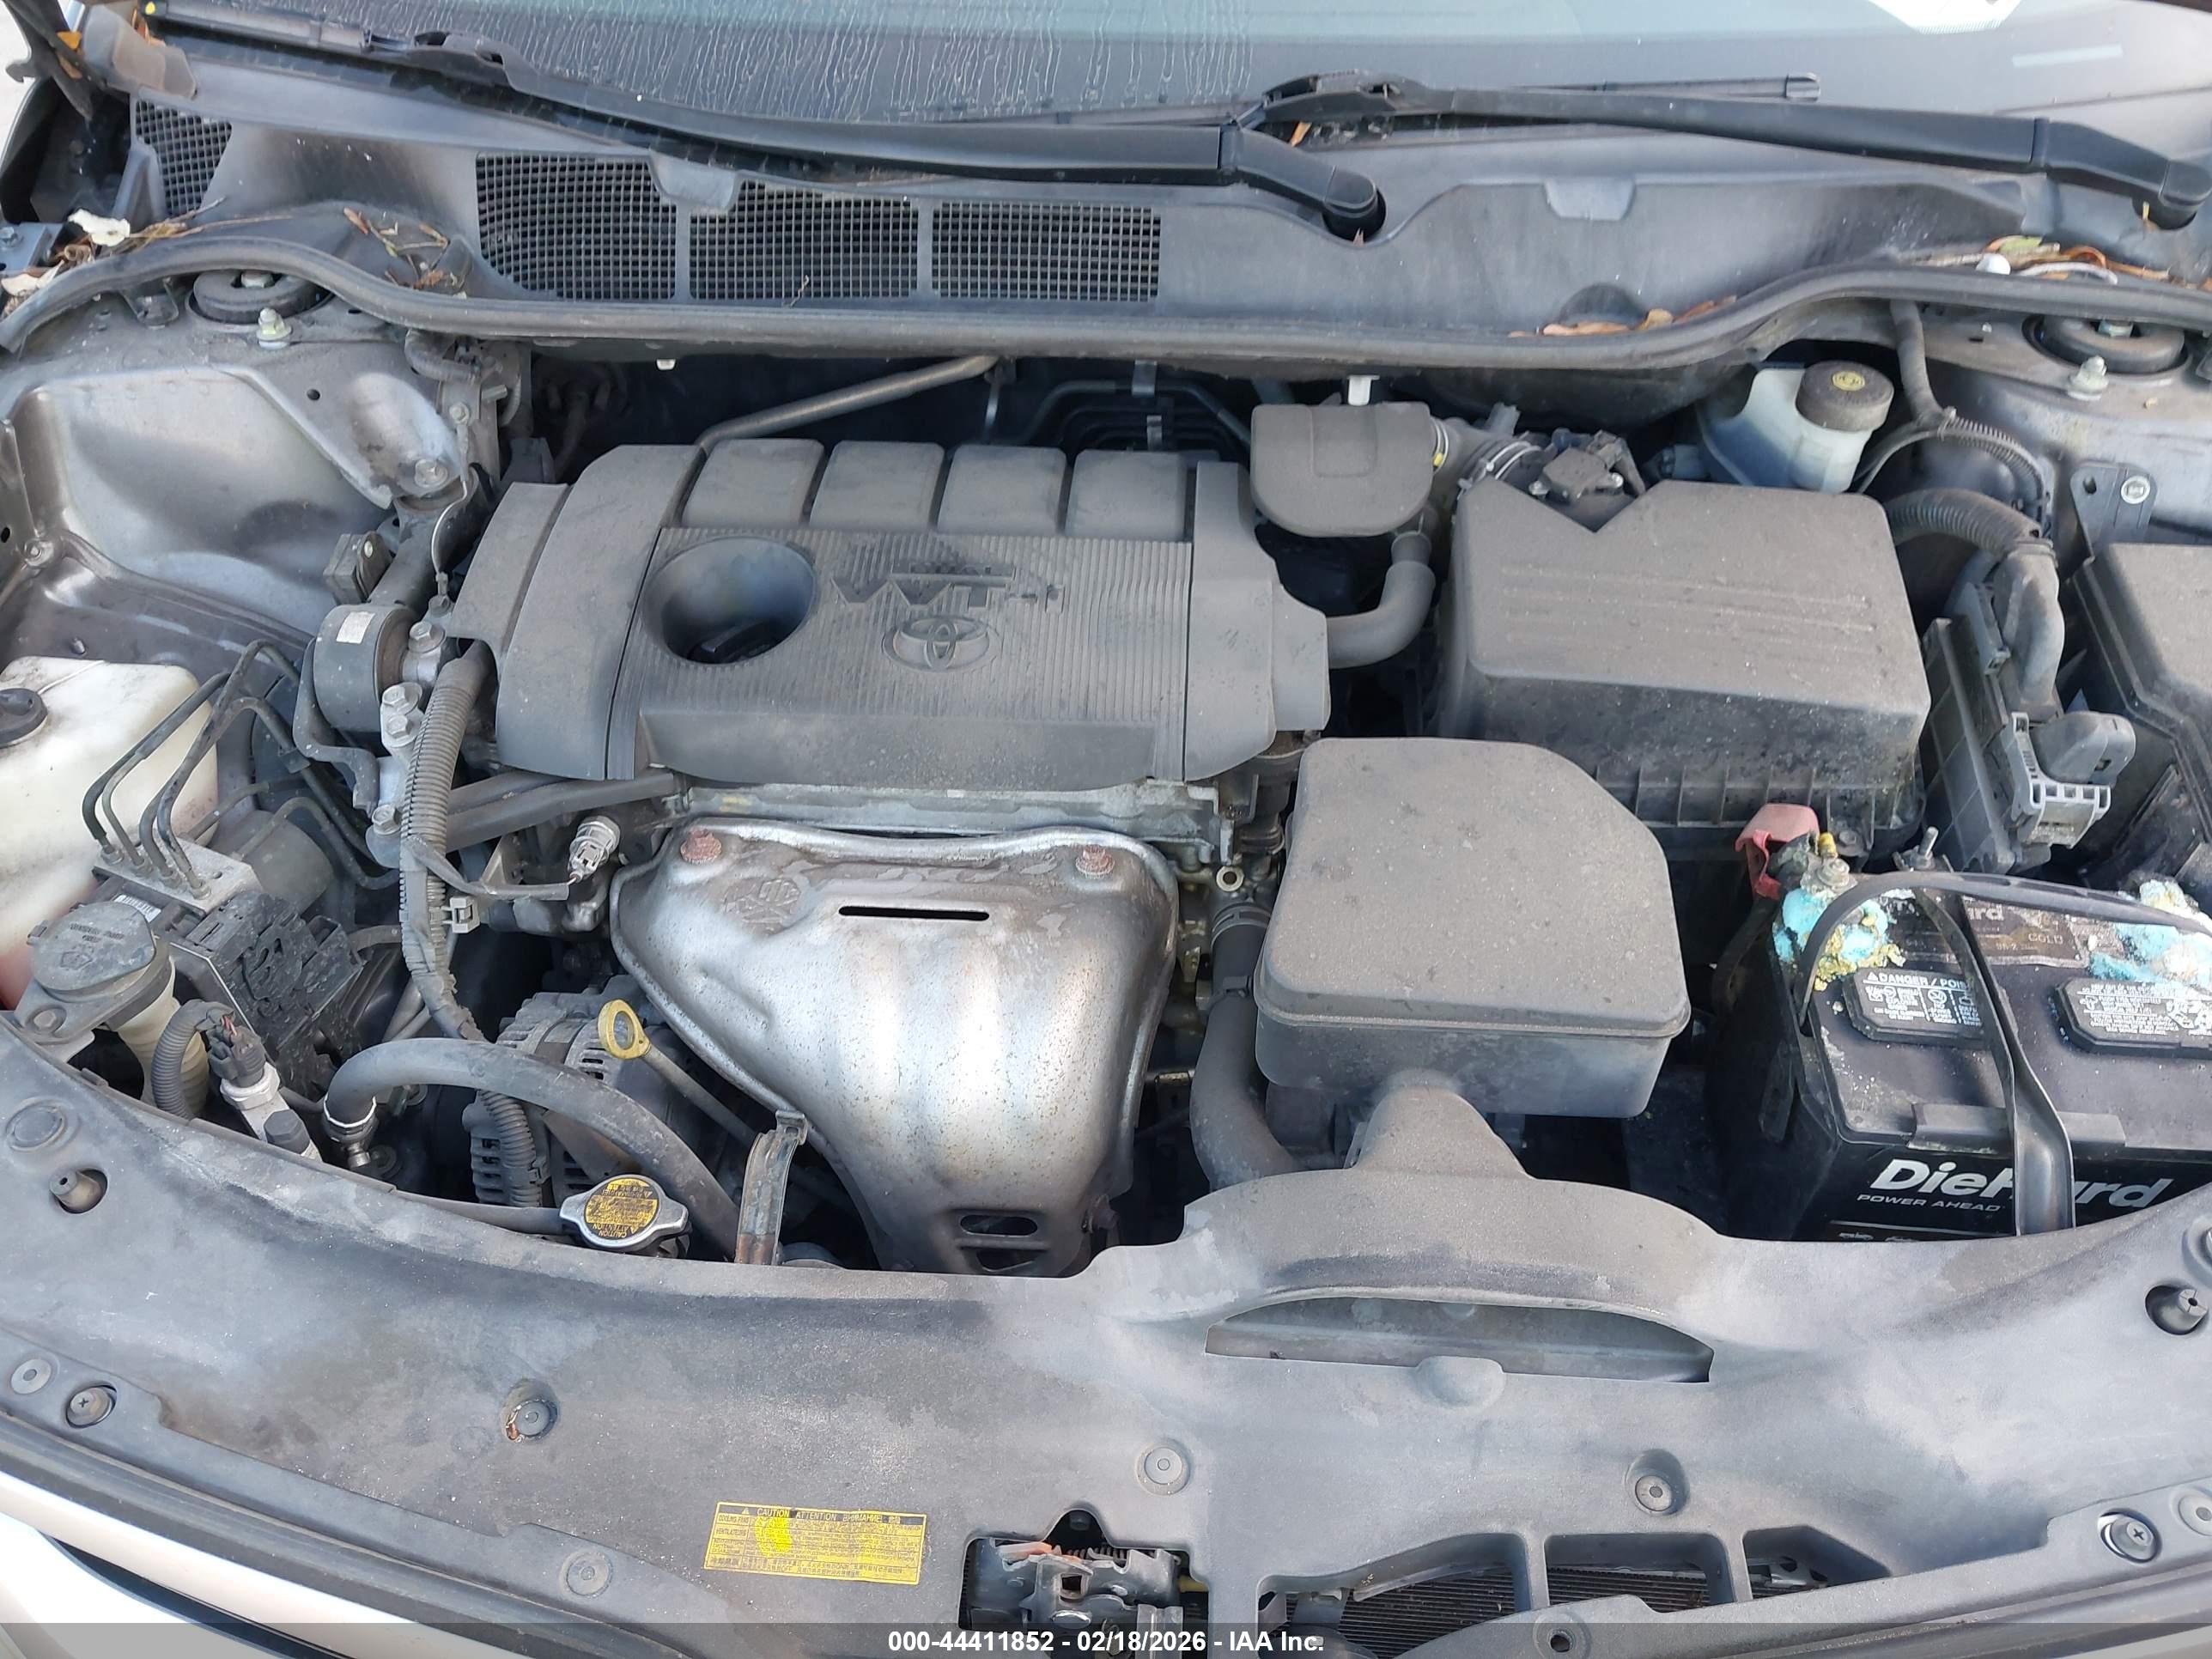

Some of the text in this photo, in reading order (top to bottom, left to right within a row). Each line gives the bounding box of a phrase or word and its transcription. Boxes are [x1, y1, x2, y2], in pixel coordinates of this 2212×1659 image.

[1879, 973, 1929, 986] DANGER
[1856, 1194, 2003, 1212] POWER AHEAD
[757, 1508, 837, 1522] CAUTION ATTENTION
